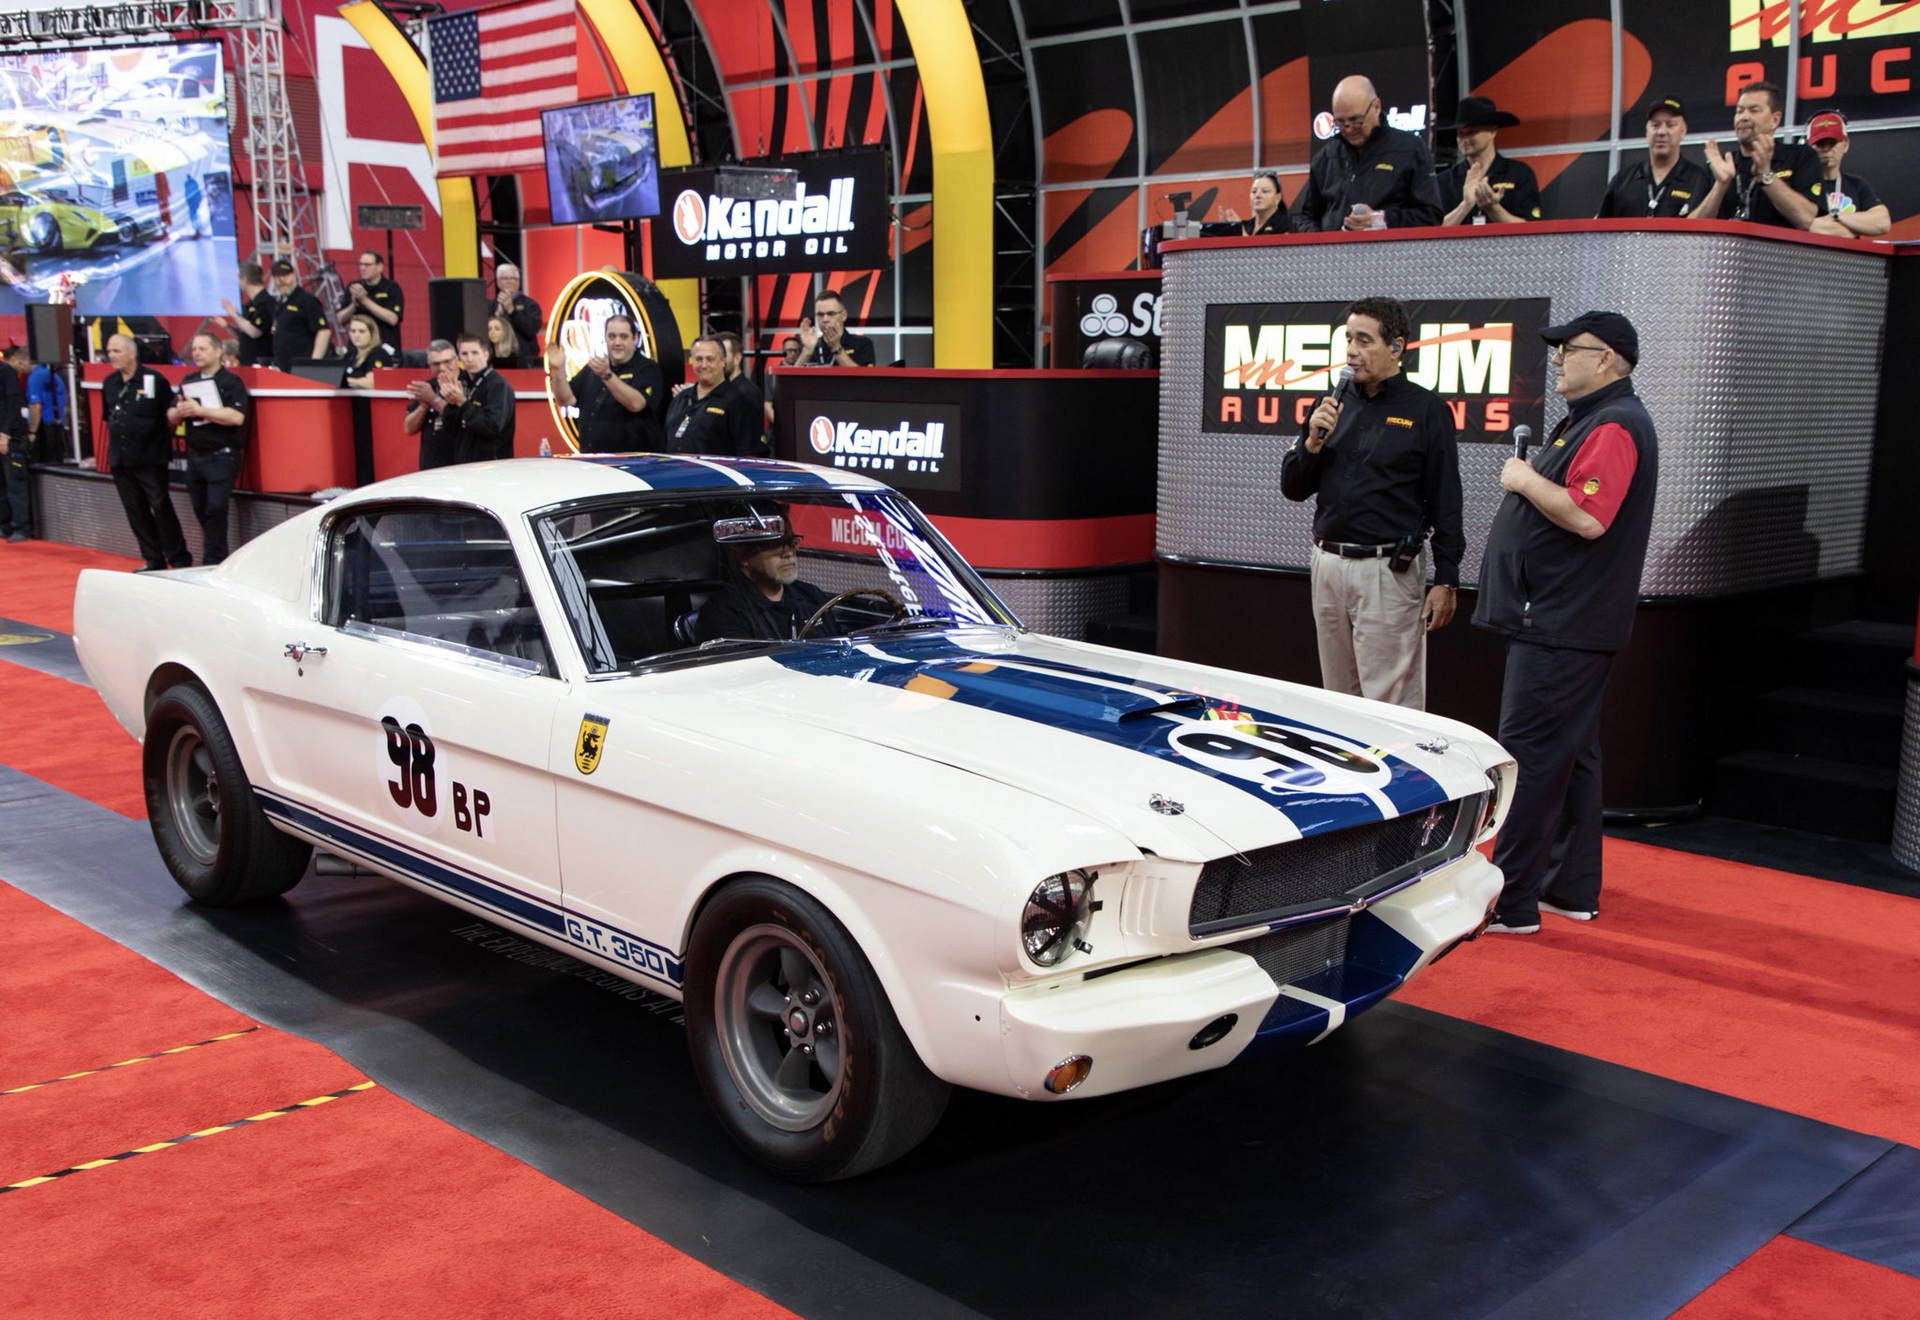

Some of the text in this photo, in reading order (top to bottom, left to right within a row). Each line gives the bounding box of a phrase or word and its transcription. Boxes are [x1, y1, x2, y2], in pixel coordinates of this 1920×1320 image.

[706, 177, 855, 241] Kendall
[706, 236, 848, 261] MOTOR OIL
[834, 421, 945, 458] Kendall
[834, 455, 940, 473] MOTOR OIL
[1176, 723, 1381, 787] 98
[380, 715, 491, 838] 98 BP
[611, 935, 665, 975] 350
